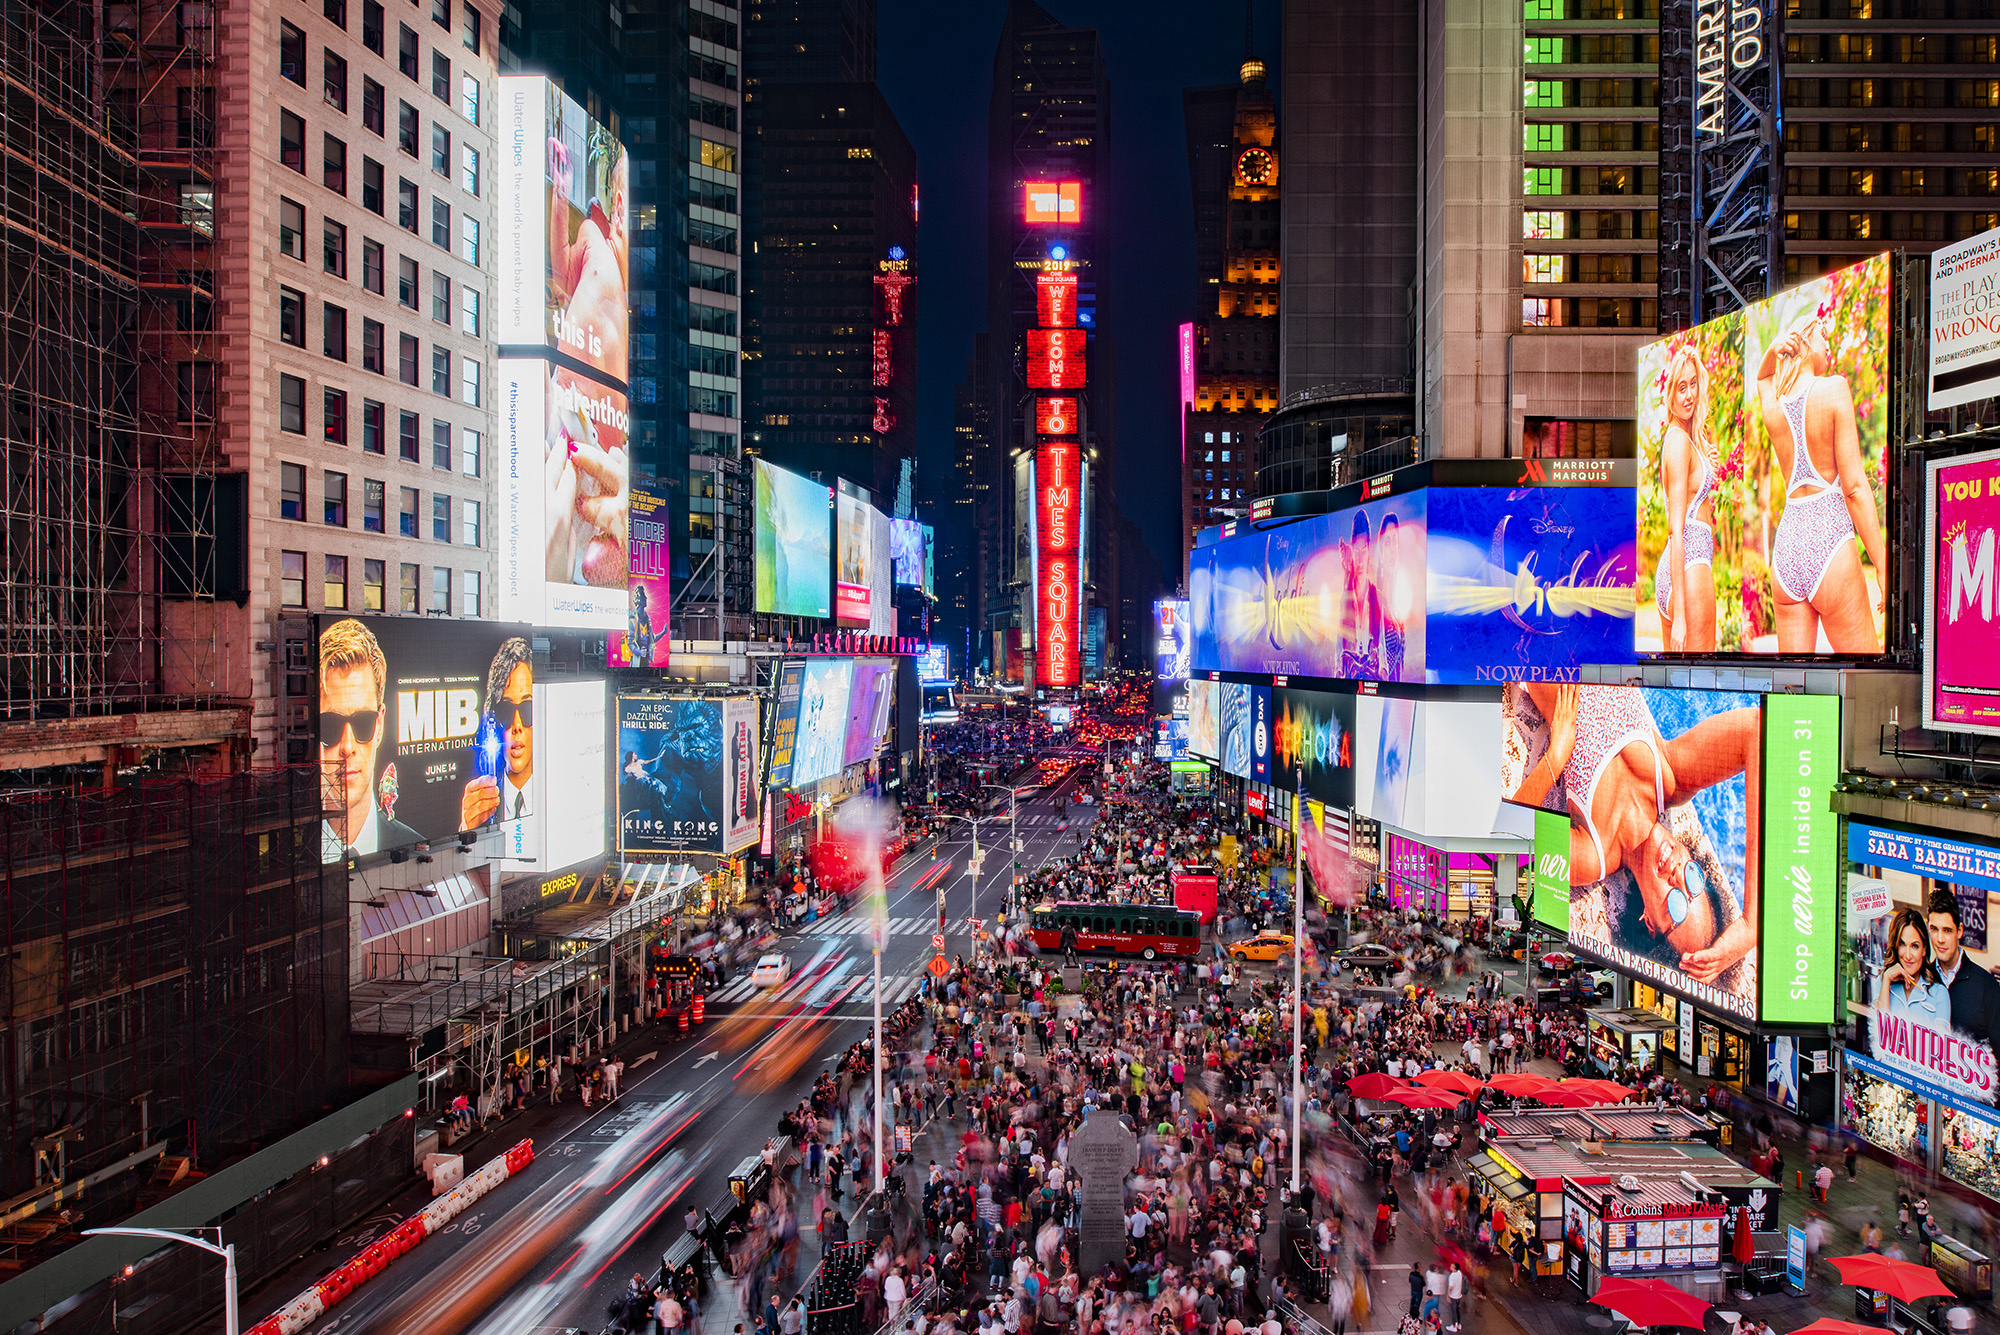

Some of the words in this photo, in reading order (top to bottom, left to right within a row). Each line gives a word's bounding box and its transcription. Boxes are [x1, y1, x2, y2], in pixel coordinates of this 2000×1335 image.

[512, 92, 524, 167] WaterWipes
[514, 173, 523, 191] the
[512, 232, 522, 264] purest
[1939, 240, 1996, 268] BROADWAY'S
[1044, 261, 1070, 271] 2019
[1935, 268, 1953, 280] AND
[512, 267, 524, 293] baby
[1940, 290, 1960, 305] THE
[1963, 272, 1998, 299] PLAY
[512, 294, 524, 328] wipes
[1935, 304, 1962, 322] THAT
[552, 307, 585, 350] this
[588, 324, 602, 358] is
[1049, 400, 1064, 432] TO
[508, 381, 519, 479] #thisisparenthood
[1553, 461, 1615, 470] MARRIOTT
[1553, 472, 1608, 481] MARQUIS
[1371, 474, 1394, 486] MARRIOTT
[1371, 484, 1392, 496] MARQUIS
[1944, 480, 1982, 502] YOU
[1048, 448, 1068, 546] TIMES
[1253, 498, 1274, 509] MARRIOTT
[509, 492, 520, 558] WaterWipes
[634, 519, 665, 543] MORE
[508, 560, 518, 597] project
[553, 598, 594, 615] WaterWipes
[1162, 607, 1174, 624] 21
[1048, 562, 1068, 681] SQUARE
[814, 633, 850, 653] 1540
[854, 634, 919, 653] BROADWAY
[1476, 666, 1528, 682] NOW
[398, 688, 480, 743] MIB
[622, 721, 647, 729] THRILL
[627, 712, 663, 720] DAZZLING
[777, 717, 796, 735] COME
[1794, 720, 1812, 740] 3!
[398, 738, 480, 756] INTERNATIONAL
[1274, 723, 1352, 768] SEPHORA
[773, 748, 792, 767] AWAY
[1799, 750, 1812, 776] on
[425, 764, 447, 776] JUNE
[448, 762, 456, 772] 14
[625, 820, 664, 830] KING
[674, 821, 718, 832] KONG
[1792, 786, 1811, 854] inside
[514, 824, 524, 854] wipes
[1868, 838, 1909, 860] SARA
[1869, 830, 1895, 840] ORIGINAL
[1896, 835, 1913, 844] MUSIC
[1923, 839, 1942, 849] 7-TIME
[541, 873, 577, 898] EXPRESS
[1863, 887, 1886, 896] STARRING
[1784, 864, 1814, 936] aerie
[1856, 903, 1870, 912] JEREMY
[1871, 900, 1886, 908] JORDAN
[1960, 906, 1985, 930] GGS
[1570, 931, 1626, 967] AMERICAN
[1630, 952, 1667, 984] EAGLE
[1669, 968, 1755, 1021] OUTFITTERS
[1790, 944, 1814, 1000] Shop
[1876, 1009, 1990, 1091] WAITRESS
[1867, 1062, 1892, 1075] ATKINSON
[1892, 1071, 1913, 1085] THEATRE
[1885, 1054, 1896, 1064] THE
[1898, 1058, 1908, 1068] HIT
[1910, 1062, 1947, 1085] BROADWAY
[1948, 1078, 1980, 1098] MUSICAL
[1623, 1205, 1662, 1217] Cousins
[1664, 1203, 1692, 1215] Maine
[1694, 1202, 1727, 1214] Lobster
